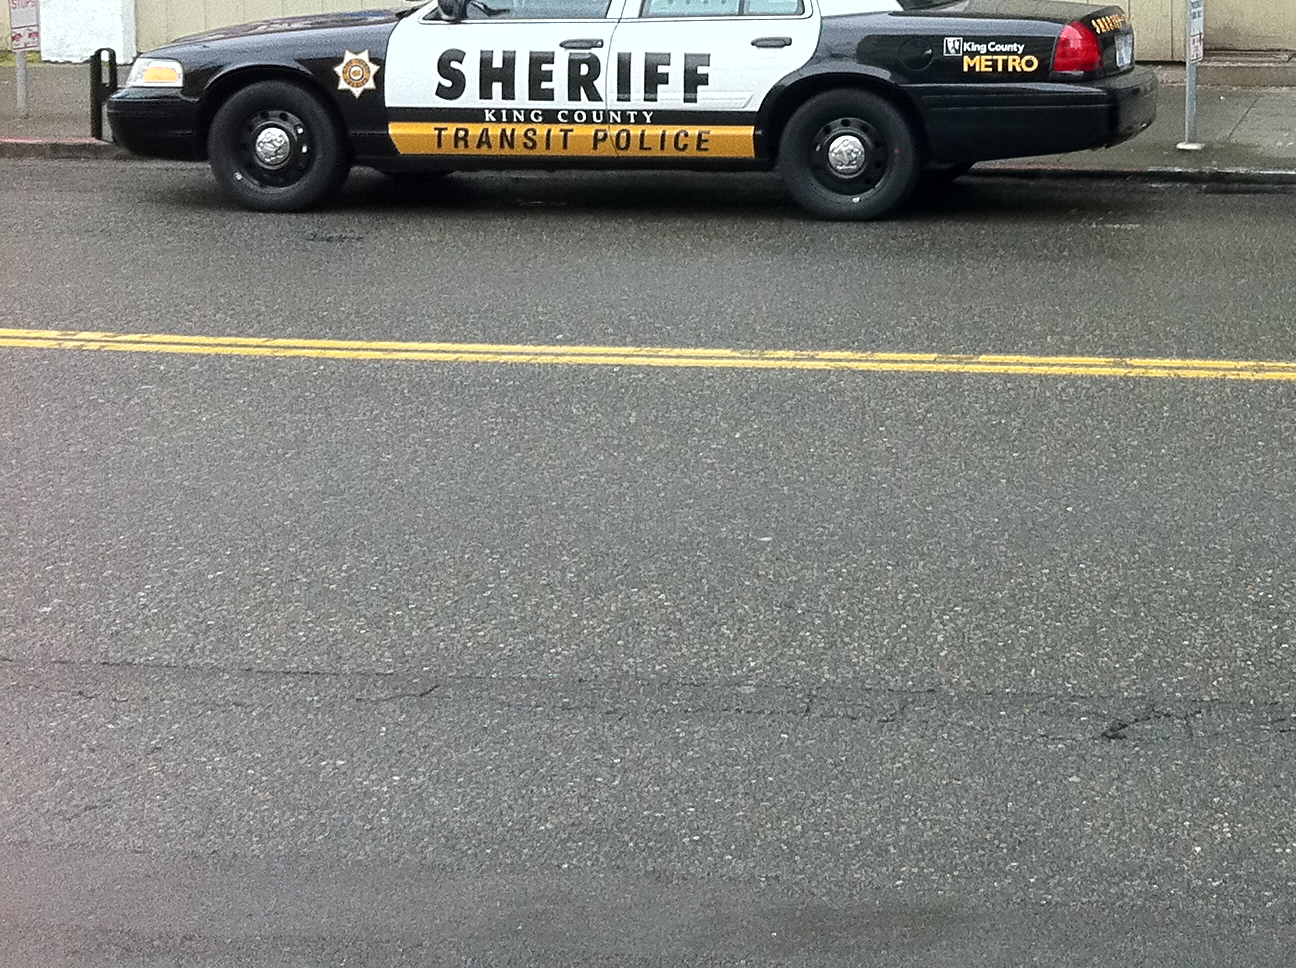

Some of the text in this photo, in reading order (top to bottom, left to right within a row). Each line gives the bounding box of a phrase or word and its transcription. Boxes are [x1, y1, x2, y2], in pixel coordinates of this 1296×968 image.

[963, 41, 1025, 54] King County
[963, 55, 1039, 73] METRO
[434, 47, 712, 104] SHERIFF
[484, 108, 656, 125] KING COUNTY
[433, 126, 712, 153] TRANSIT POLICE
